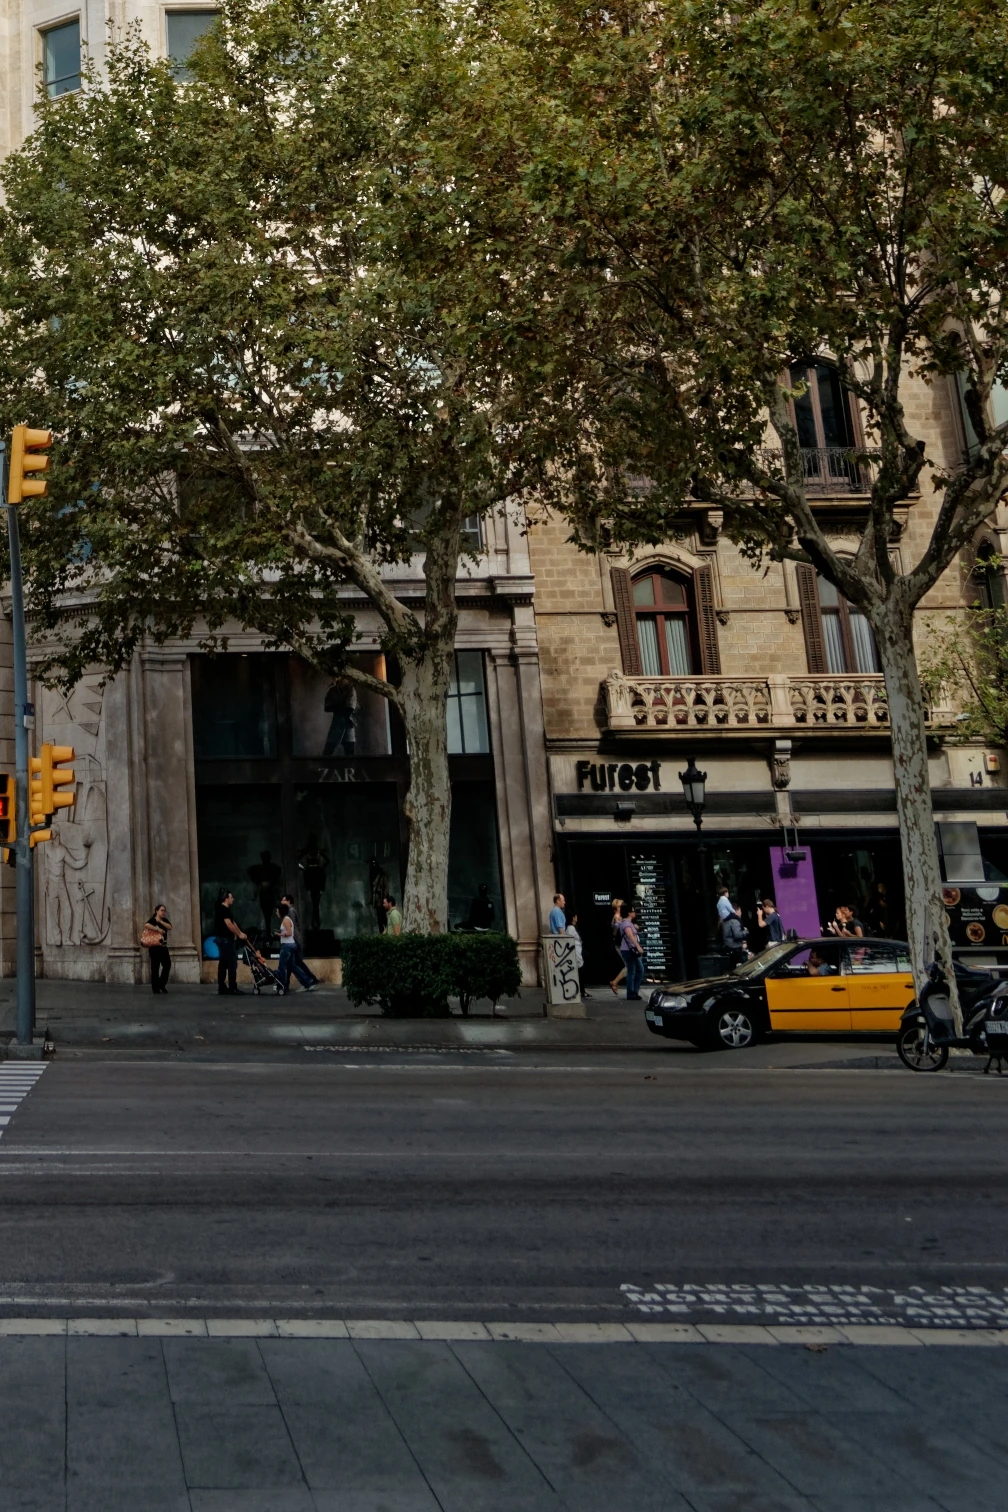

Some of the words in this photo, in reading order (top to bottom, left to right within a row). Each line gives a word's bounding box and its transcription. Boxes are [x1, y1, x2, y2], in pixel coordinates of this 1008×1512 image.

[576, 759, 661, 792] Furest
[969, 771, 984, 787] 14
[620, 1283, 643, 1291] A
[626, 1293, 791, 1303] MORTS
[807, 1294, 872, 1305] EN
[637, 1304, 692, 1313] DE
